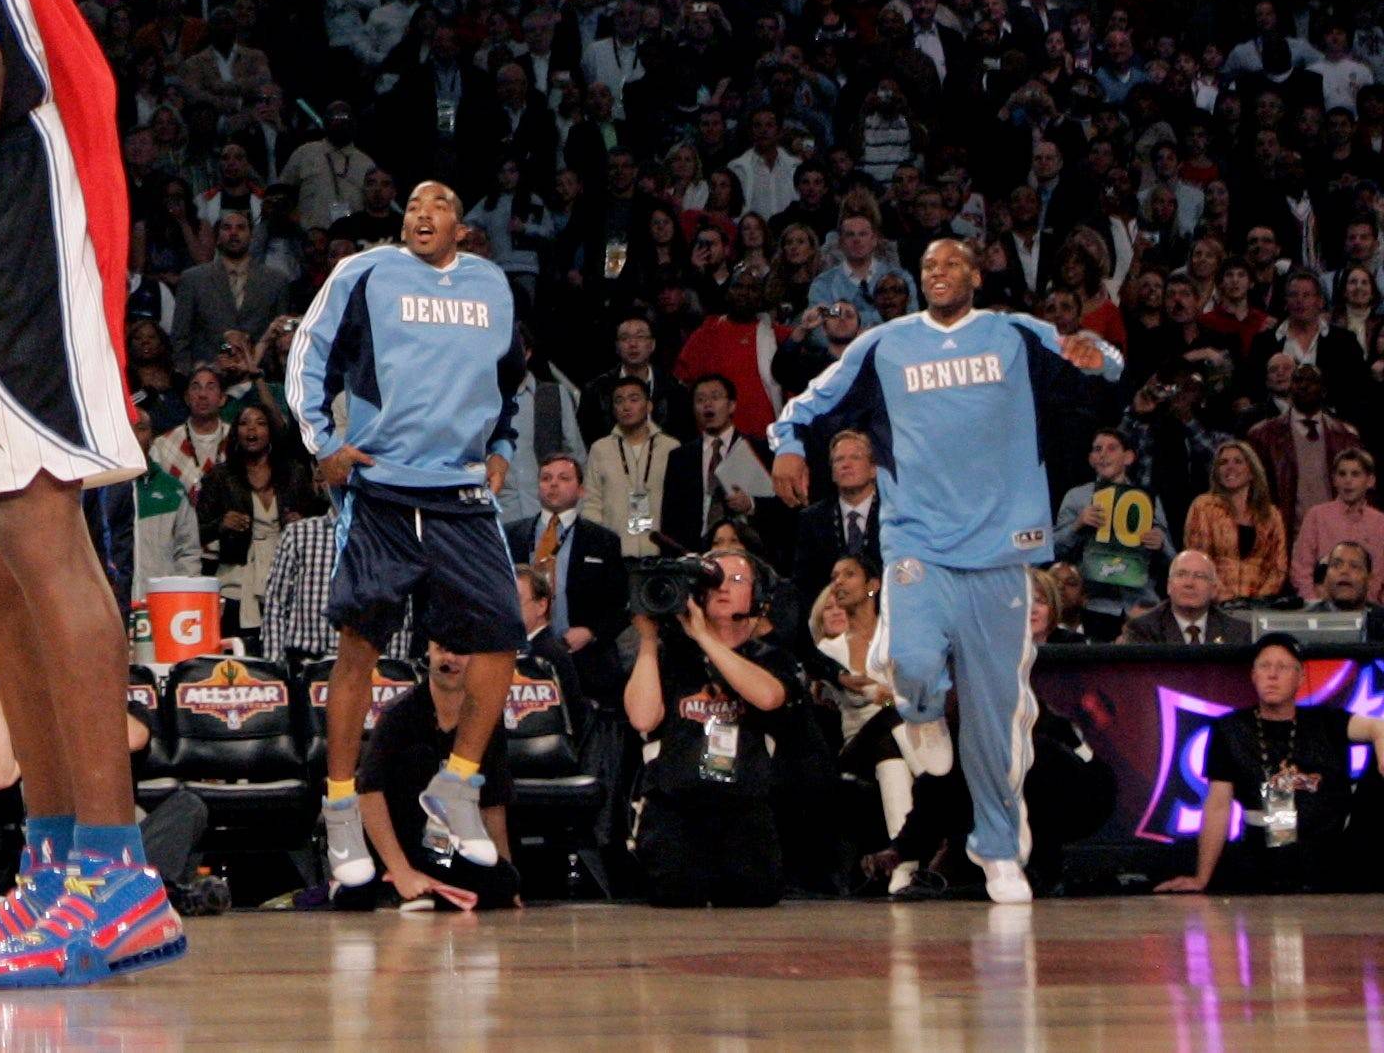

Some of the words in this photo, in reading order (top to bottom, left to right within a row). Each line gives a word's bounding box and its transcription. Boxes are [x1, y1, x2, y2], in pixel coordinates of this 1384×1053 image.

[401, 296, 489, 328] DENVER
[904, 356, 1002, 393] DENVER
[1092, 486, 1153, 547] 10
[170, 610, 201, 645] G
